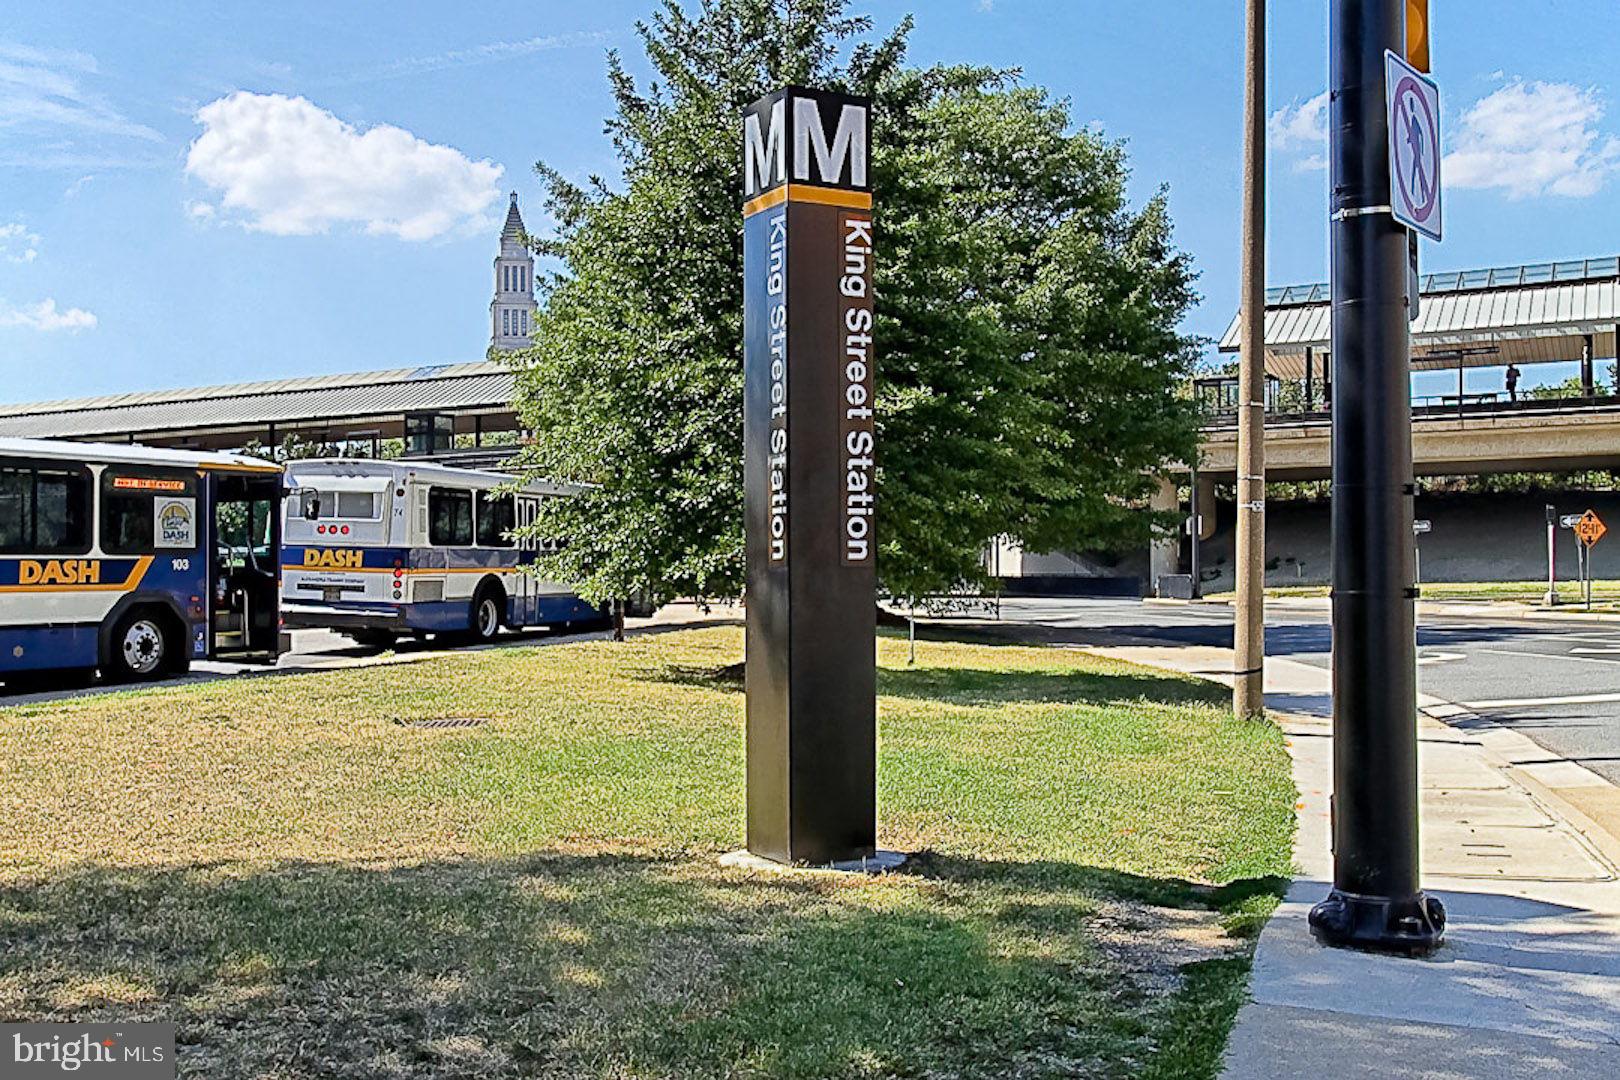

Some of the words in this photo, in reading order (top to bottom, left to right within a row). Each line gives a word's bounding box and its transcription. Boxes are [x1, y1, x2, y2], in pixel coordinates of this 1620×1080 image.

[744, 98, 786, 197] M
[793, 96, 867, 187] M
[767, 214, 787, 296] King
[839, 219, 872, 298] King
[770, 305, 787, 419] Street
[845, 308, 873, 420] Street
[163, 530, 189, 540] DASH
[770, 429, 787, 561] Station
[846, 431, 874, 561] Station
[18, 560, 100, 585] DASH
[172, 558, 190, 571] 103
[304, 548, 364, 568] DASH
